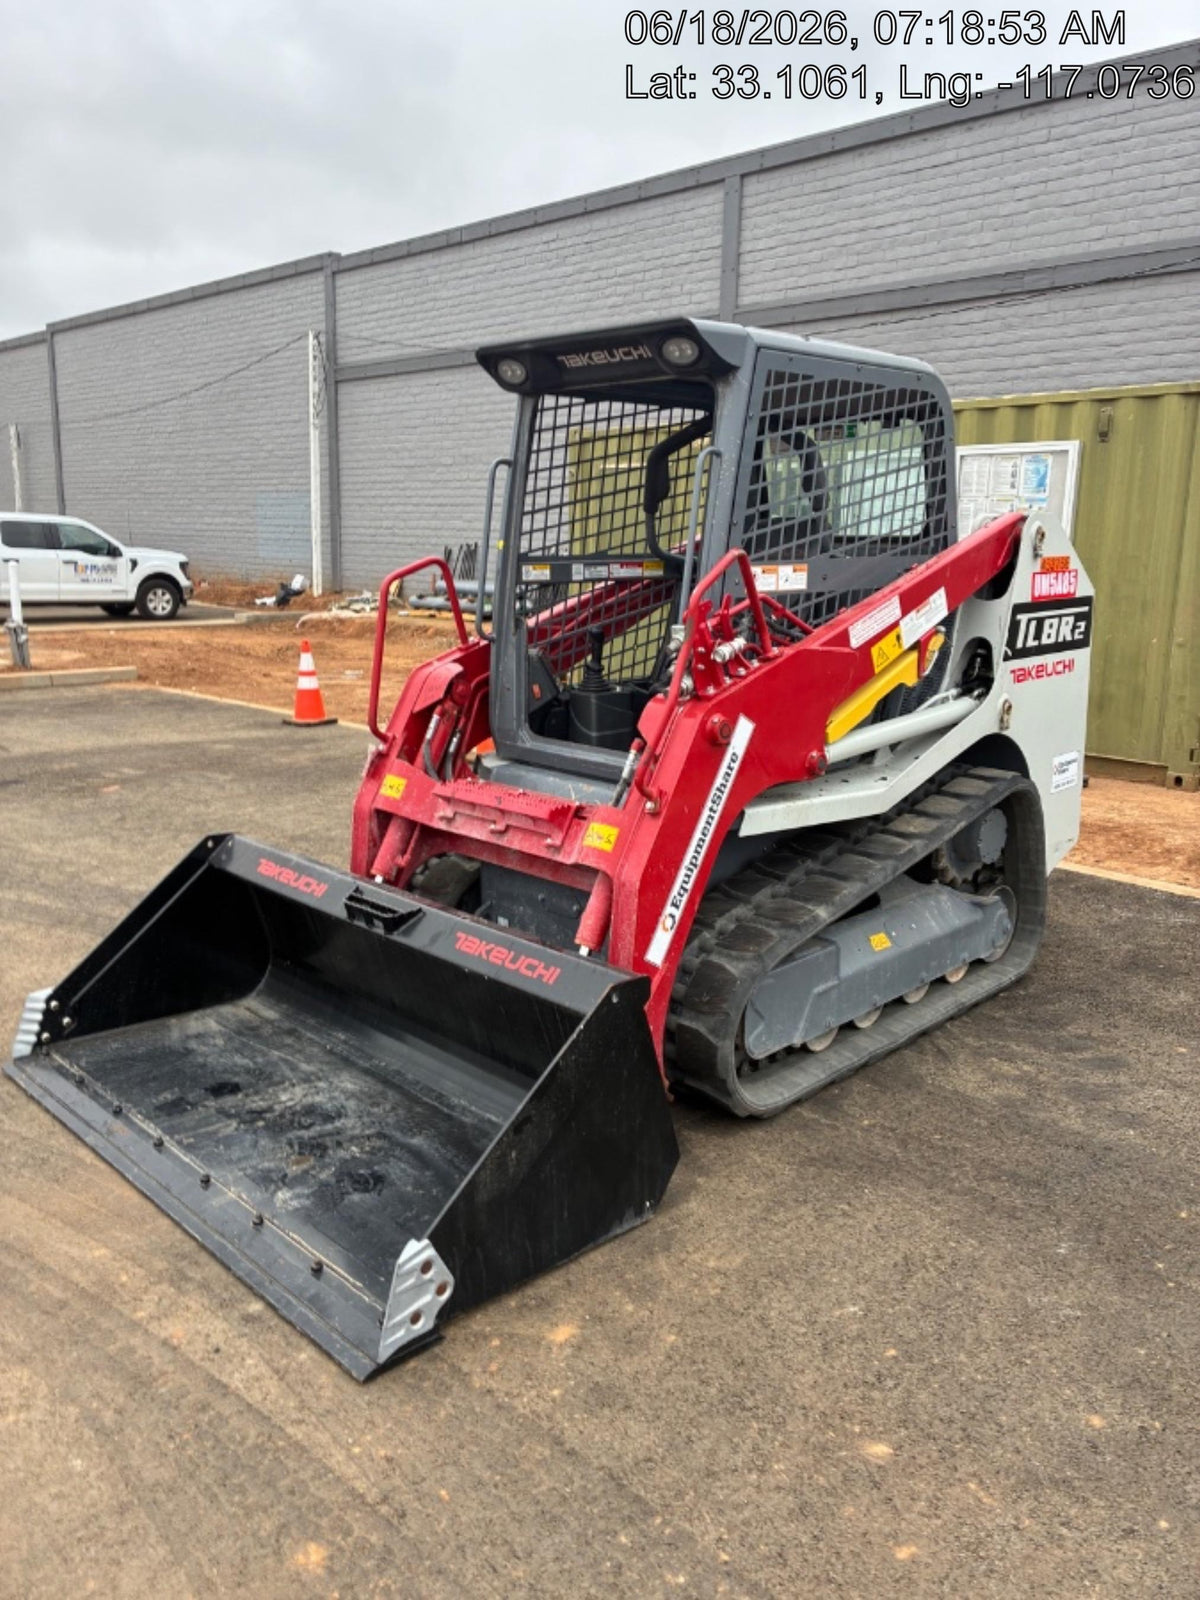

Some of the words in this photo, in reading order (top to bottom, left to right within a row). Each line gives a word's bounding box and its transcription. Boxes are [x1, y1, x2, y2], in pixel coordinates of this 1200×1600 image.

[556, 345, 652, 368] TAKEUCHI
[1009, 658, 1075, 684] TAKEUCHI
[670, 750, 739, 911] EquipmentShare
[256, 857, 328, 898] TAKEUCHI
[454, 931, 561, 986] TAKEUCHI
